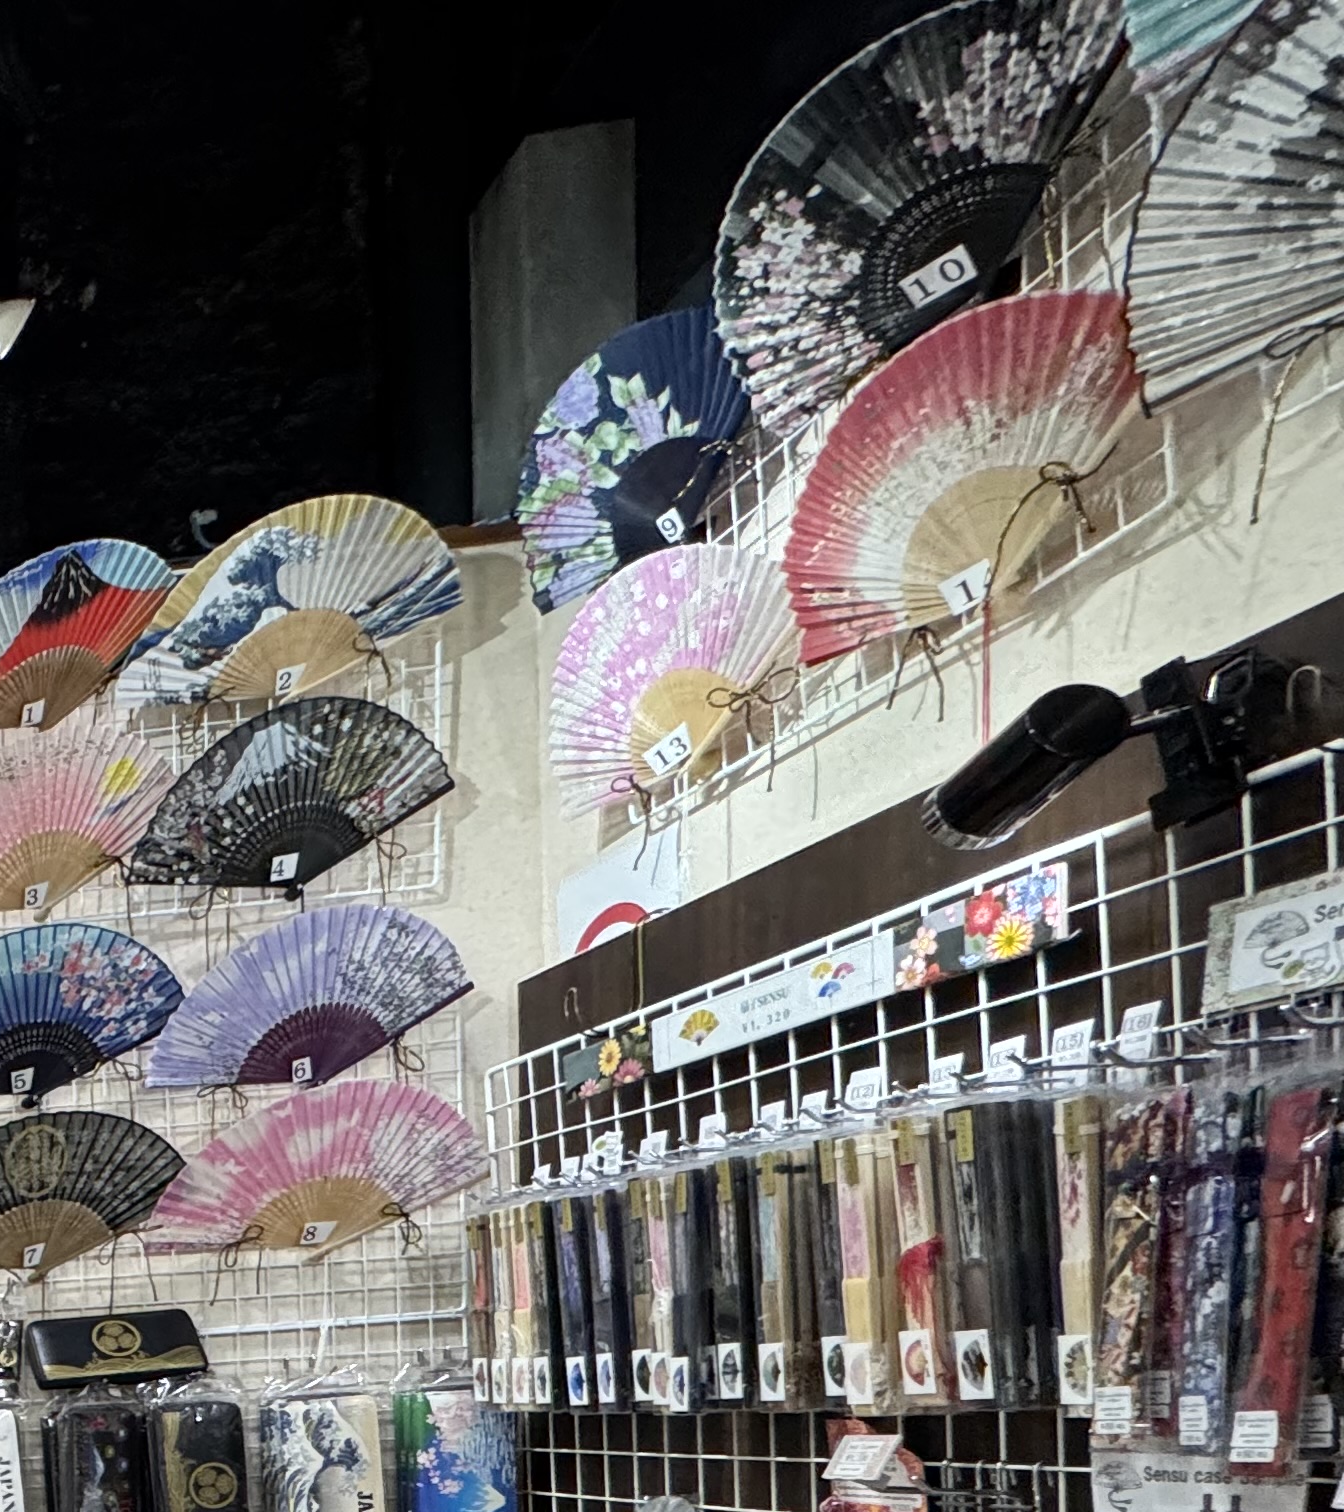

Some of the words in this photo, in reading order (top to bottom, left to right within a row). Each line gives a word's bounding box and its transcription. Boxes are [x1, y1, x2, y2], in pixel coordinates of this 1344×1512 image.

[908, 258, 966, 303] 10
[661, 517, 679, 538] 9
[278, 671, 292, 692] 2
[26, 706, 34, 724] 1
[654, 736, 688, 769] 13
[271, 859, 285, 877] 4
[26, 888, 38, 907] 3
[293, 1061, 306, 1079] 6
[14, 1073, 26, 1090] 5
[302, 1225, 318, 1242] 8
[25, 1247, 37, 1264] 7
[1144, 1466, 1188, 1483] Sensu
[1194, 1468, 1232, 1485] case
